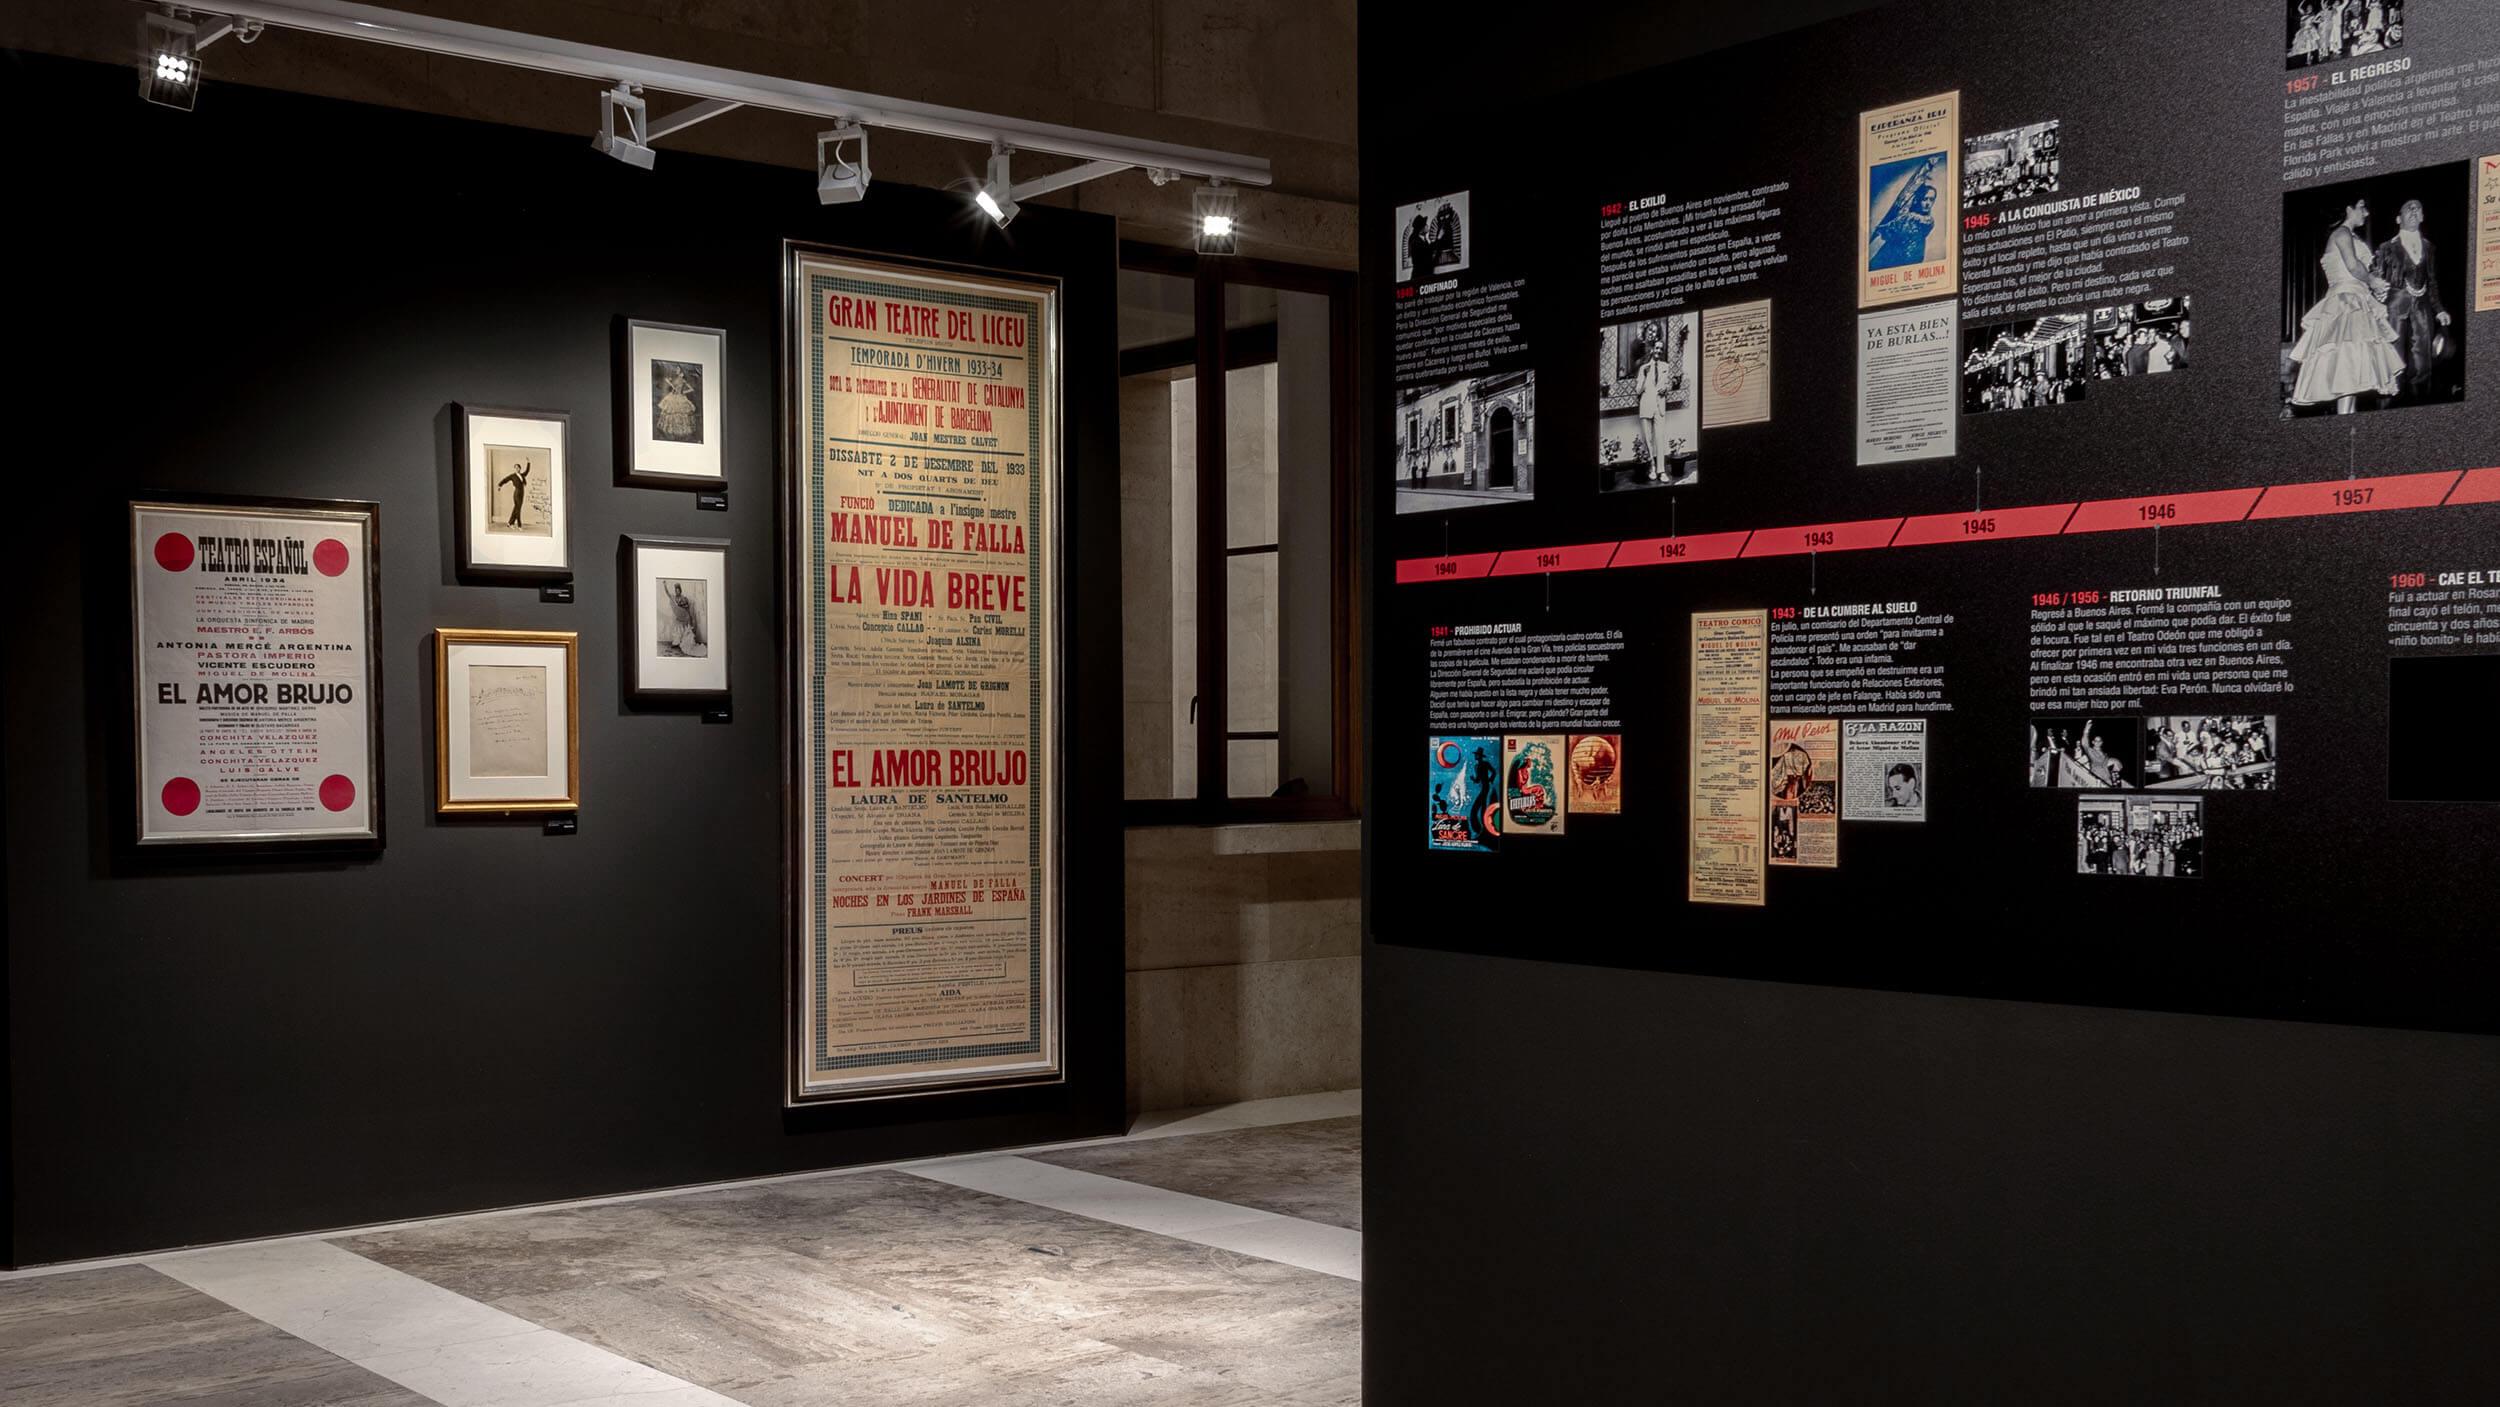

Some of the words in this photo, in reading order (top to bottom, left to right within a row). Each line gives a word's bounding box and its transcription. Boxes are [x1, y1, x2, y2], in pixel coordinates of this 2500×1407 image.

[2285, 75, 2318, 94] 1957
[2331, 72, 2346, 84] EL
[2350, 57, 2411, 81] REGRESO
[1601, 203, 1622, 217] 1942
[1629, 200, 1639, 211] EL
[1640, 194, 1666, 209] EXILIO
[1963, 213, 1990, 229] 1945
[1999, 212, 2006, 223] A
[2008, 210, 2021, 222] LA
[2023, 198, 2080, 219] CONQUISTA
[2083, 196, 2096, 208] DE
[2099, 187, 2140, 205] MÉXICO
[1870, 273, 1898, 287] MIGUEL
[1903, 270, 1912, 281] DE
[1918, 264, 1946, 279] MOLINA
[1420, 279, 1458, 295] CONFINADO
[829, 296, 877, 331] GRAN
[885, 303, 940, 339] TEATRE
[948, 311, 975, 342] DEL
[983, 314, 1024, 347] LICEU
[1867, 328, 1882, 338] YA
[1887, 323, 1916, 335] ESTA
[1920, 318, 1949, 330] BIEN
[1867, 340, 1883, 350] DE
[851, 347, 909, 369] TEMPORADA
[917, 354, 960, 373] D'HIVERN
[967, 360, 1002, 377] 1933-34
[912, 377, 960, 403] GENERALITAT
[968, 383, 978, 405] DE
[984, 384, 1025, 409] CATALUNYA
[935, 407, 944, 428] DE
[951, 408, 992, 432] BARCELONA
[910, 432, 927, 442] JOAN
[934, 434, 966, 445] MESTRES
[971, 437, 998, 447] CALVET
[830, 448, 882, 465] DISSABTE
[890, 455, 896, 466] 2
[904, 456, 918, 468] DE
[924, 457, 973, 472] DESEMBRE
[982, 462, 998, 474] DEL
[1007, 463, 1025, 475] 1933
[894, 472, 912, 480] DOS
[919, 474, 957, 483] QUARTS
[964, 477, 976, 485] DE
[982, 478, 999, 486] DEU
[2332, 488, 2374, 506] 1957
[889, 500, 933, 514] DEDICADA
[940, 507, 945, 515] a
[990, 507, 1016, 519] mestre
[2139, 504, 2176, 520] 1946
[831, 513, 917, 546] MANUEL
[928, 520, 952, 549] DE
[964, 522, 1025, 553] FALLA
[1962, 518, 1996, 535] 1945
[1804, 531, 1834, 547] 1943
[198, 536, 250, 572] TEATRO
[253, 536, 308, 575] ESPAÑOL
[1659, 543, 1686, 558] 1942
[1434, 562, 1457, 576] 1940
[1536, 554, 1560, 568] 1941
[2391, 573, 2425, 587] 1960
[2439, 572, 2464, 585] CAE
[2468, 571, 2484, 584] EL
[831, 565, 862, 604] LA
[876, 568, 934, 607] VIDA
[948, 572, 1025, 612] BREVE
[2032, 594, 2059, 606] 1946
[2062, 594, 2068, 606] /
[2071, 592, 2099, 605] 1956
[2110, 589, 2162, 603] RETORNO
[2166, 586, 2221, 600] TRIUNFAL
[2389, 592, 2404, 602] Fui
[2416, 592, 2449, 601] actuar
[1772, 608, 1795, 619] 1943
[1804, 607, 1816, 618] DE
[1818, 607, 1830, 617] LA
[1831, 604, 1870, 617] CUMBRE
[1872, 604, 1884, 614] AL
[1886, 602, 1917, 613] SUELO
[2031, 609, 2065, 619] Regresé
[2067, 610, 2072, 618] a
[2075, 607, 2106, 617] Buenos
[2109, 606, 2133, 616] Aires.
[2136, 604, 2165, 614] Formé
[2167, 604, 2175, 613] la
[2177, 601, 2221, 613] compañía
[2223, 601, 2241, 611] con
[2244, 600, 2256, 609] un
[2258, 599, 2291, 610] equipo
[197, 626, 249, 635] MAESTRO
[252, 627, 262, 635] E.
[1431, 627, 1448, 637] 1941
[1455, 625, 1492, 636] PROHIBIDO
[1493, 623, 1521, 634] ACTUAR
[1698, 619, 1729, 627] TEATRO
[226, 642, 271, 650] MERCÉ
[279, 643, 352, 651] ARGENTINA
[252, 662, 315, 670] ESCUDERO
[158, 683, 186, 704] EL
[197, 683, 268, 704] AMOR
[278, 684, 352, 704] BRUJO
[2030, 699, 2045, 711] que
[2047, 700, 2062, 709] esa
[2064, 699, 2088, 710] mujer
[2091, 698, 2109, 708] hizo
[2111, 699, 2125, 710] por
[1859, 723, 1876, 732] LA
[1879, 722, 1922, 731] RAZON
[833, 750, 860, 787] EL
[871, 750, 941, 787] AMOR
[950, 750, 1026, 786] BRUJO
[851, 795, 897, 804] LAURA
[909, 795, 926, 804] DE
[936, 793, 1008, 803] SANTELMO
[930, 880, 968, 890] MANUEL
[974, 879, 984, 888] DE
[989, 878, 1016, 888] FALLA
[833, 895, 868, 908] NOCHES
[876, 894, 889, 906] EN
[897, 893, 914, 906] LOS
[922, 891, 966, 904] JARDINES
[973, 891, 984, 902] DE
[992, 888, 1026, 902] ESPAÑA
[908, 908, 932, 918] FRANK
[935, 907, 973, 916] MARSHALL
[892, 927, 923, 936] PREUS
